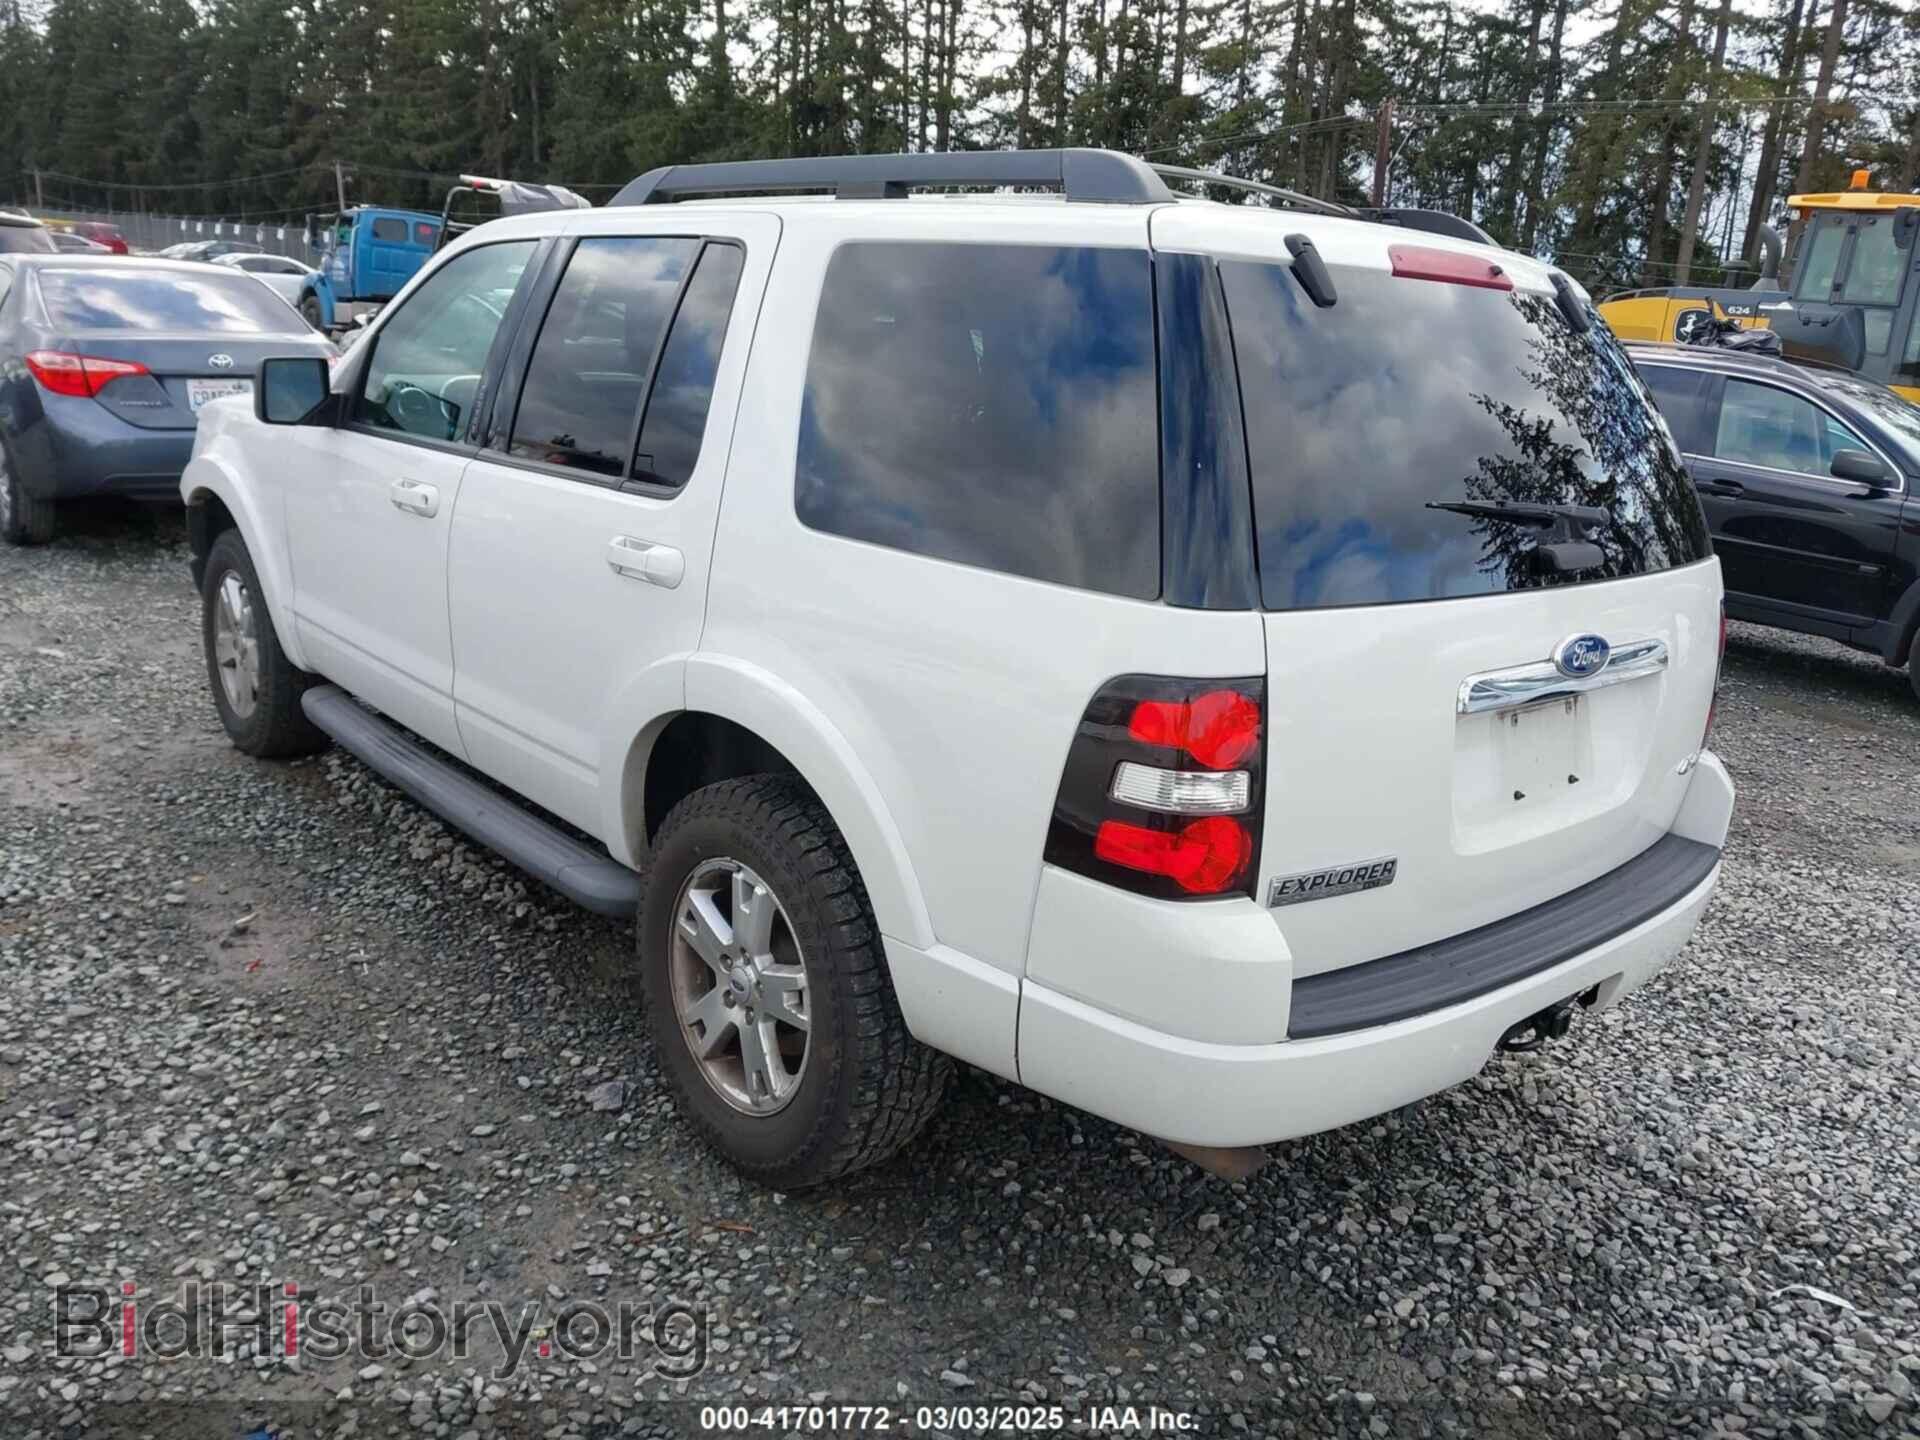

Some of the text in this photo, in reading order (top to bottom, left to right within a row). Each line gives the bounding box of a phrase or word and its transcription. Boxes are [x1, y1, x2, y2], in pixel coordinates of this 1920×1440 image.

[1727, 305, 1751, 315] 624
[1572, 640, 1602, 667] Ford
[1276, 859, 1397, 896] EXPLORER
